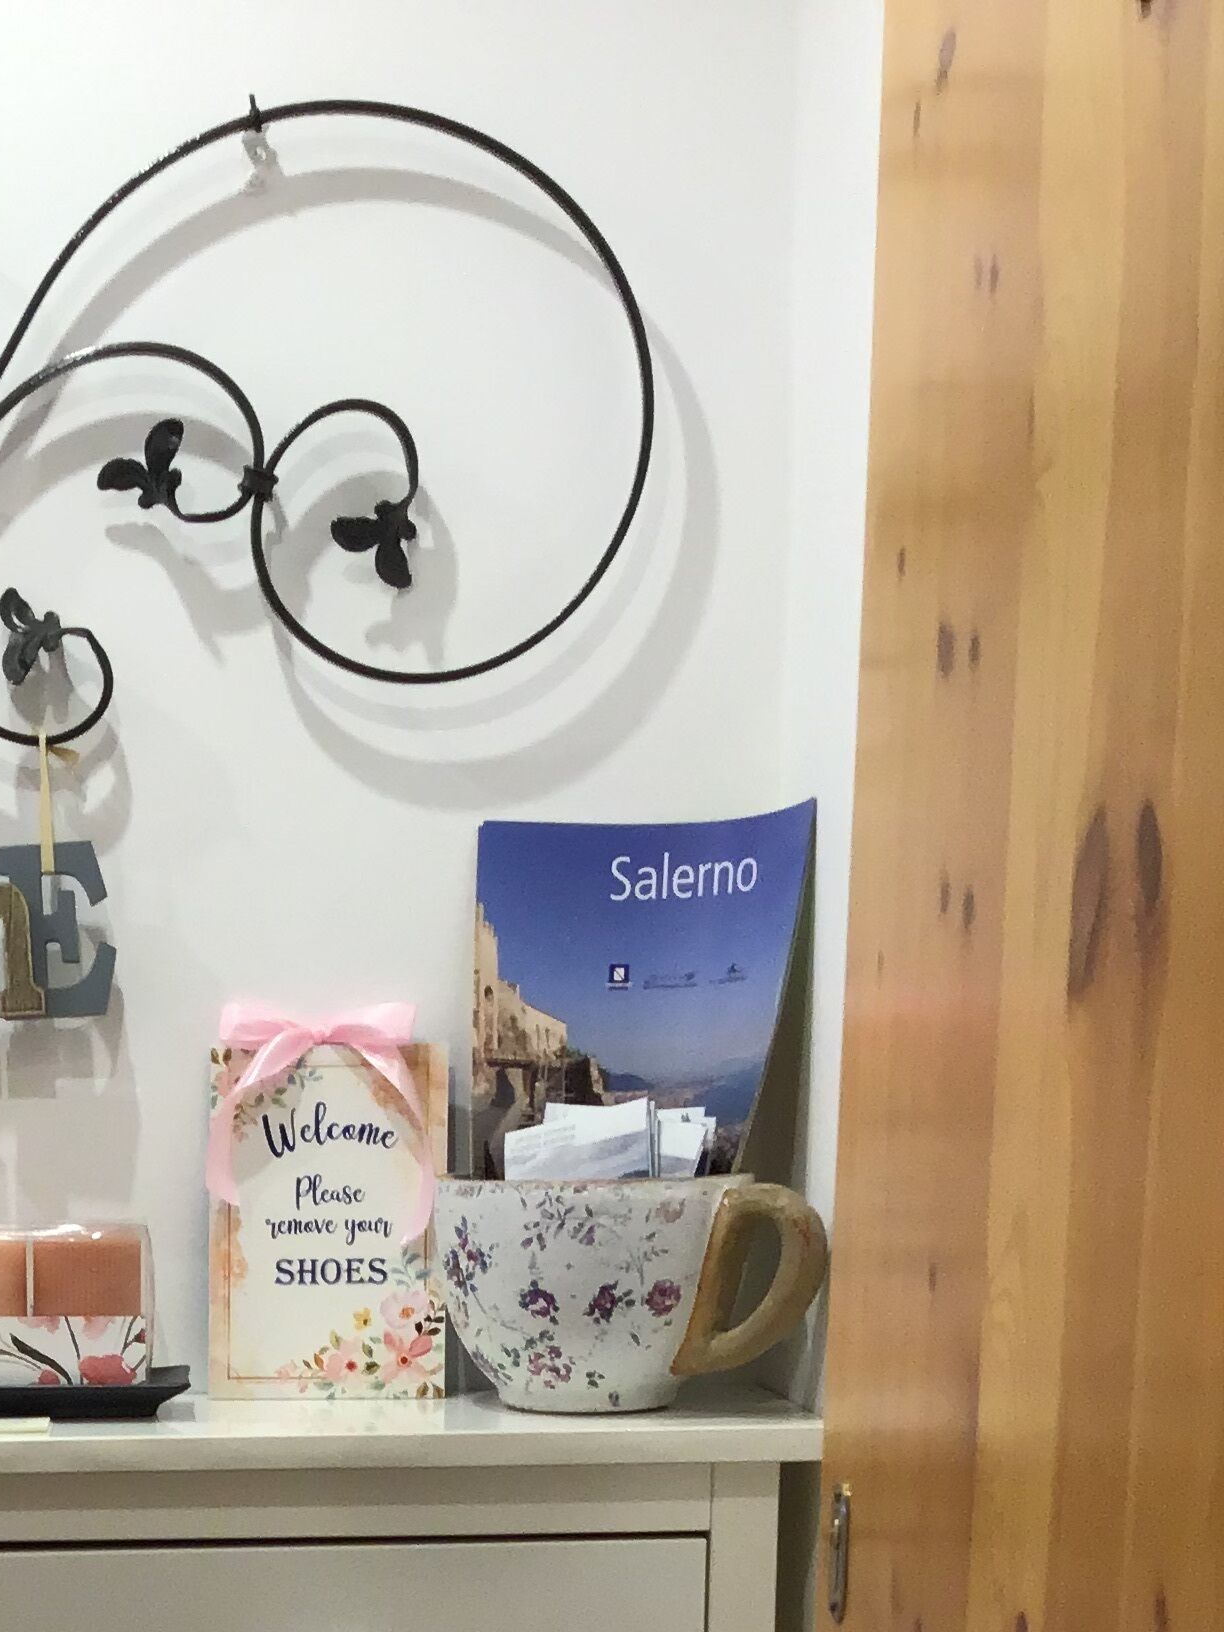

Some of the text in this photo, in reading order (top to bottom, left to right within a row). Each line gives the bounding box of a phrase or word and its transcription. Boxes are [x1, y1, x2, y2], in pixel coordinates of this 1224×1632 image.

[610, 851, 758, 901] Salerno
[261, 1101, 399, 1158] Welcome
[295, 1174, 365, 1210] Please
[265, 1216, 394, 1246] remove your
[275, 1257, 388, 1286] SHOES
